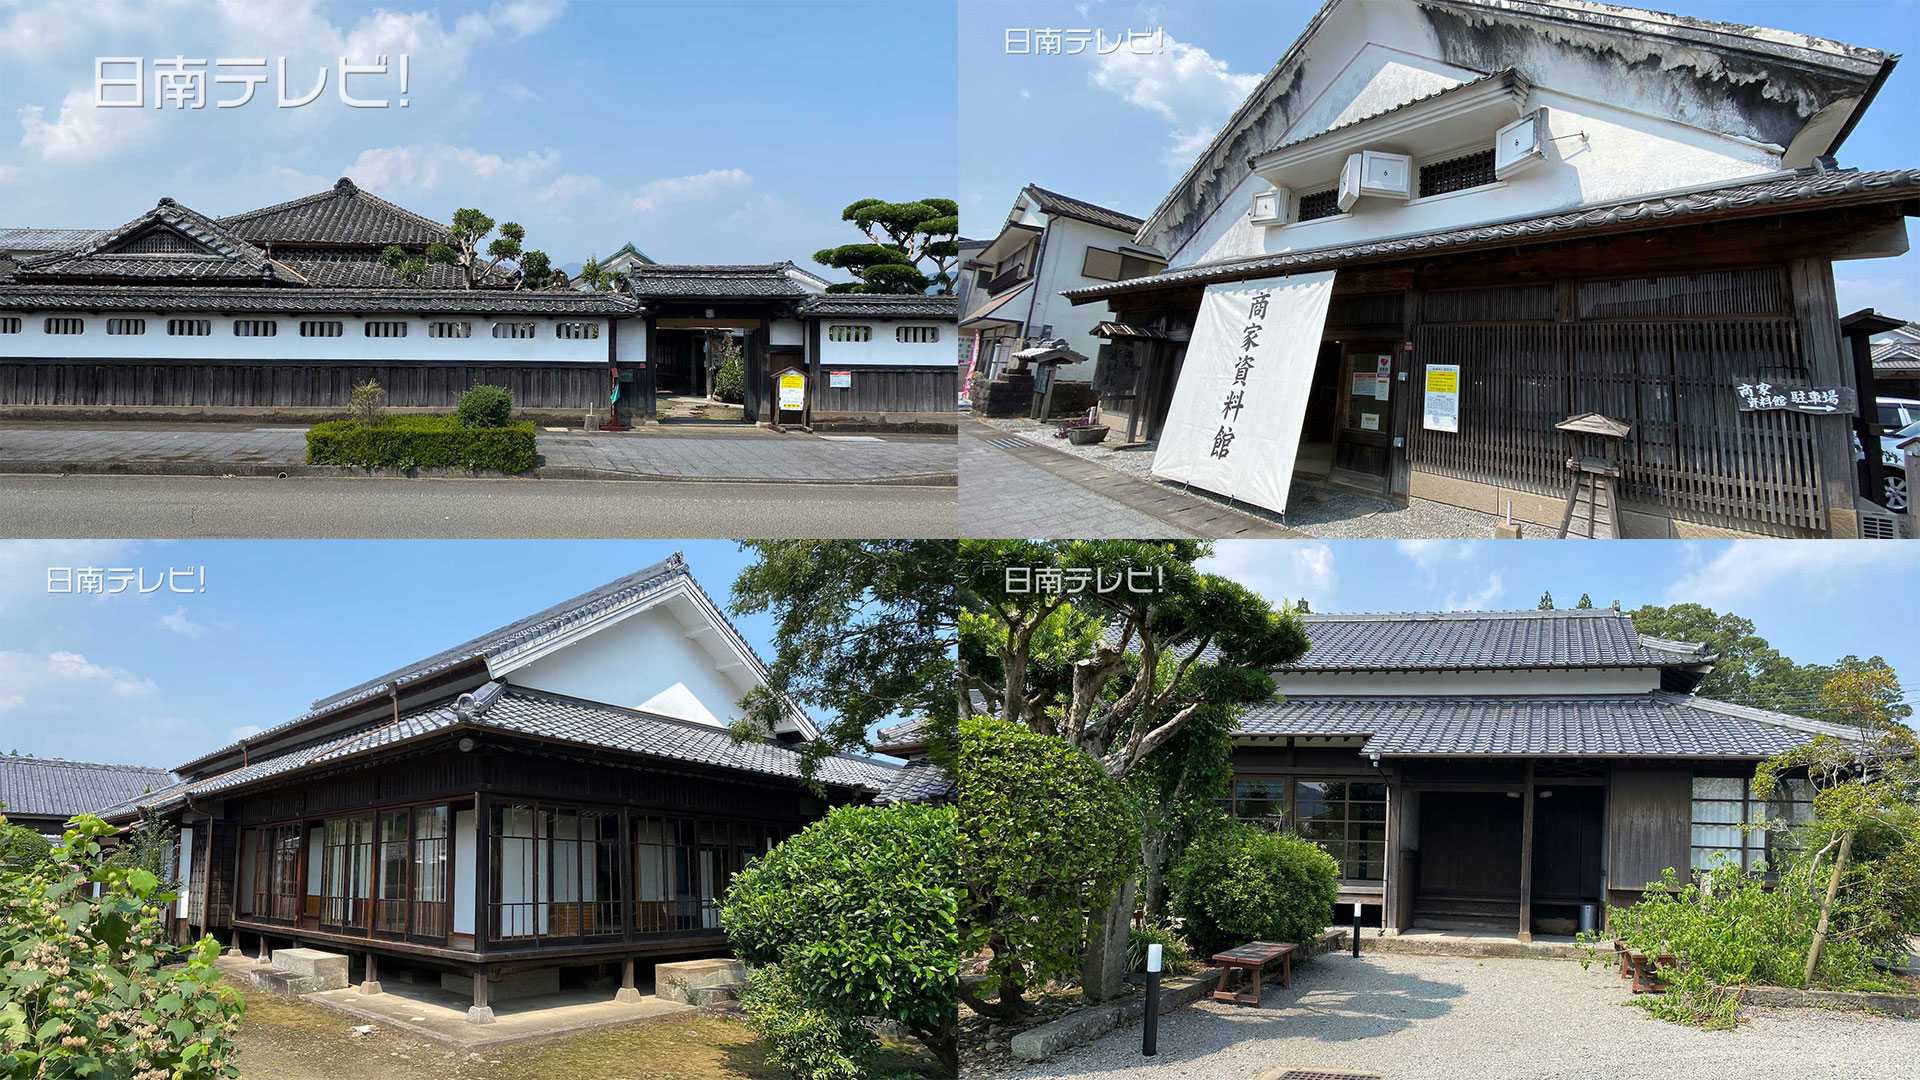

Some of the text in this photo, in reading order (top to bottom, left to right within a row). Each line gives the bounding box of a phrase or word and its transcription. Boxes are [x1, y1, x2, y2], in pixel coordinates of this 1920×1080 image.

[1210, 292, 1271, 460] 商家資料館
[1737, 382, 1772, 398] 商家
[1790, 389, 1840, 405] 駐車場
[1747, 395, 1788, 409] 資料館
